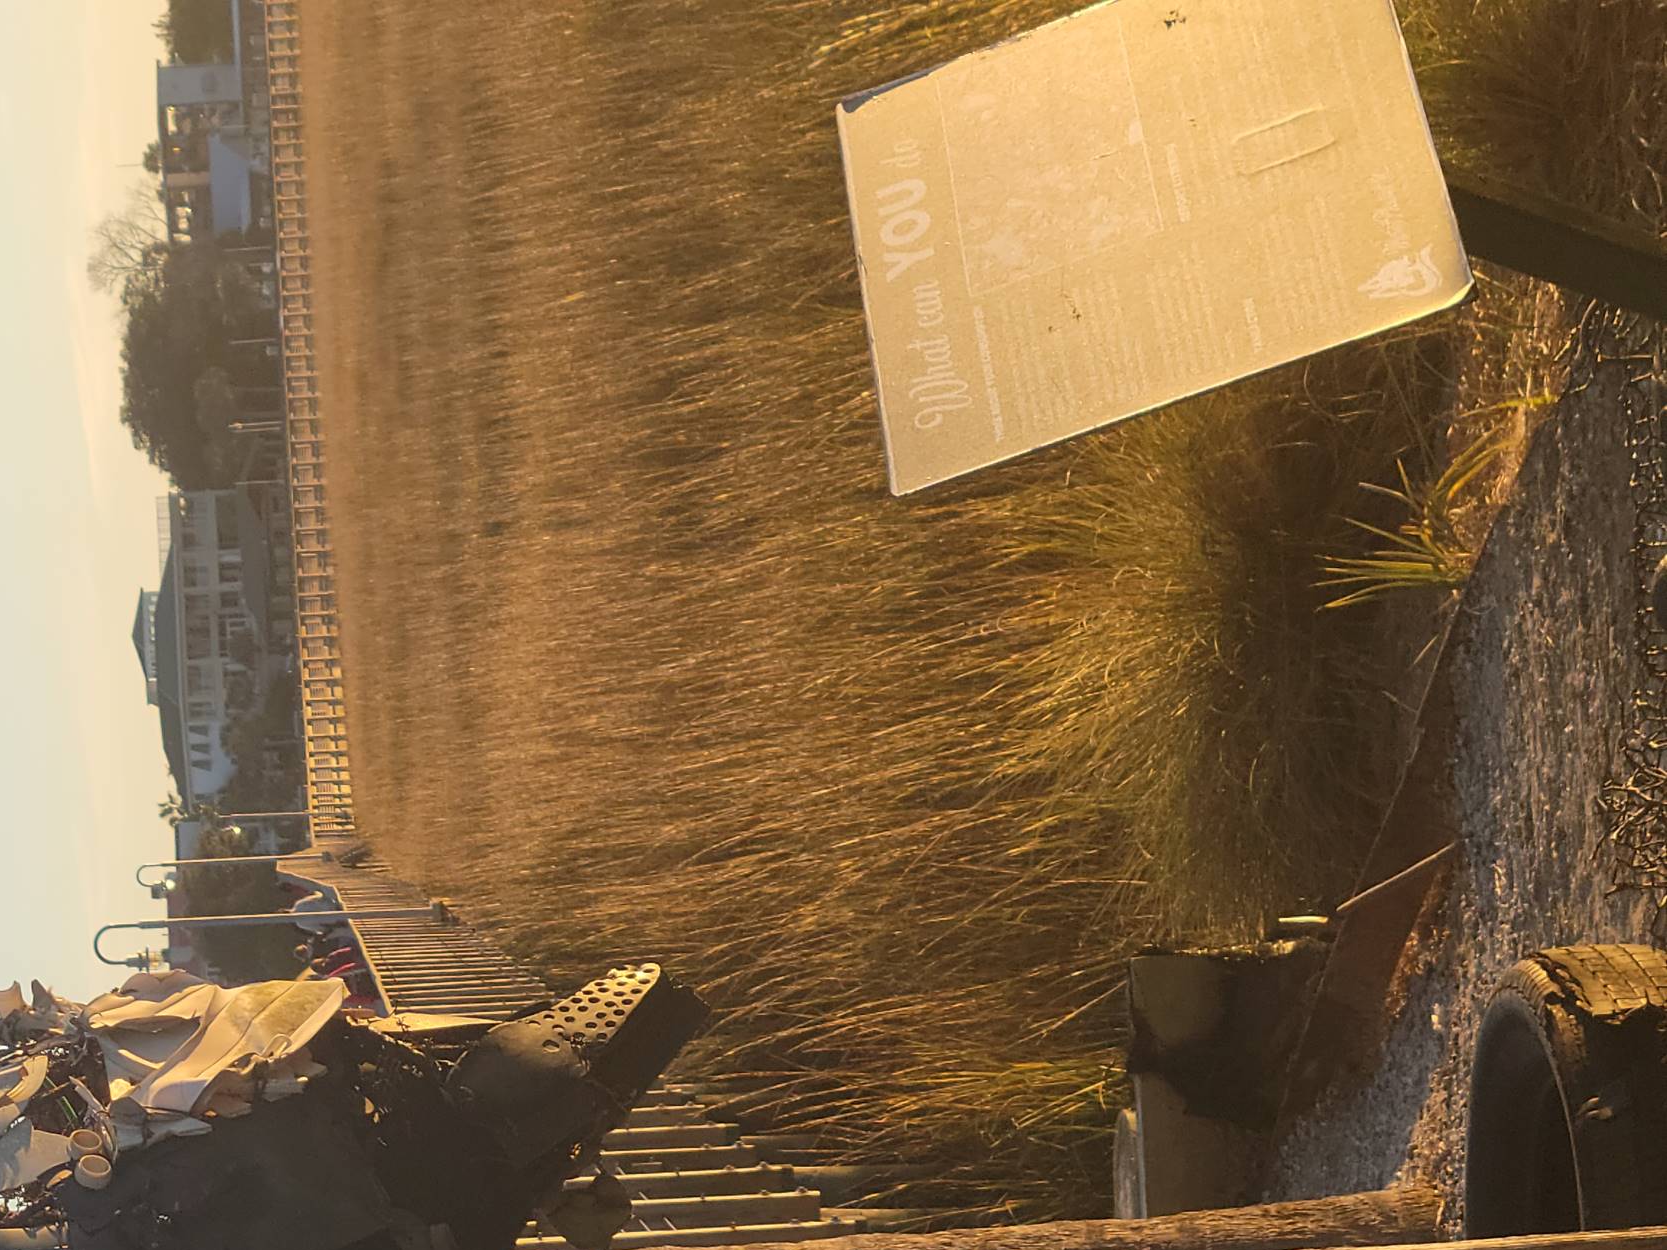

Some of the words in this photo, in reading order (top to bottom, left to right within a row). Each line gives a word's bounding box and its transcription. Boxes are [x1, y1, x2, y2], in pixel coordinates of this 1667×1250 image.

[879, 137, 921, 168] do
[875, 177, 934, 282] YOU
[911, 278, 944, 328] can
[906, 333, 972, 430] What
